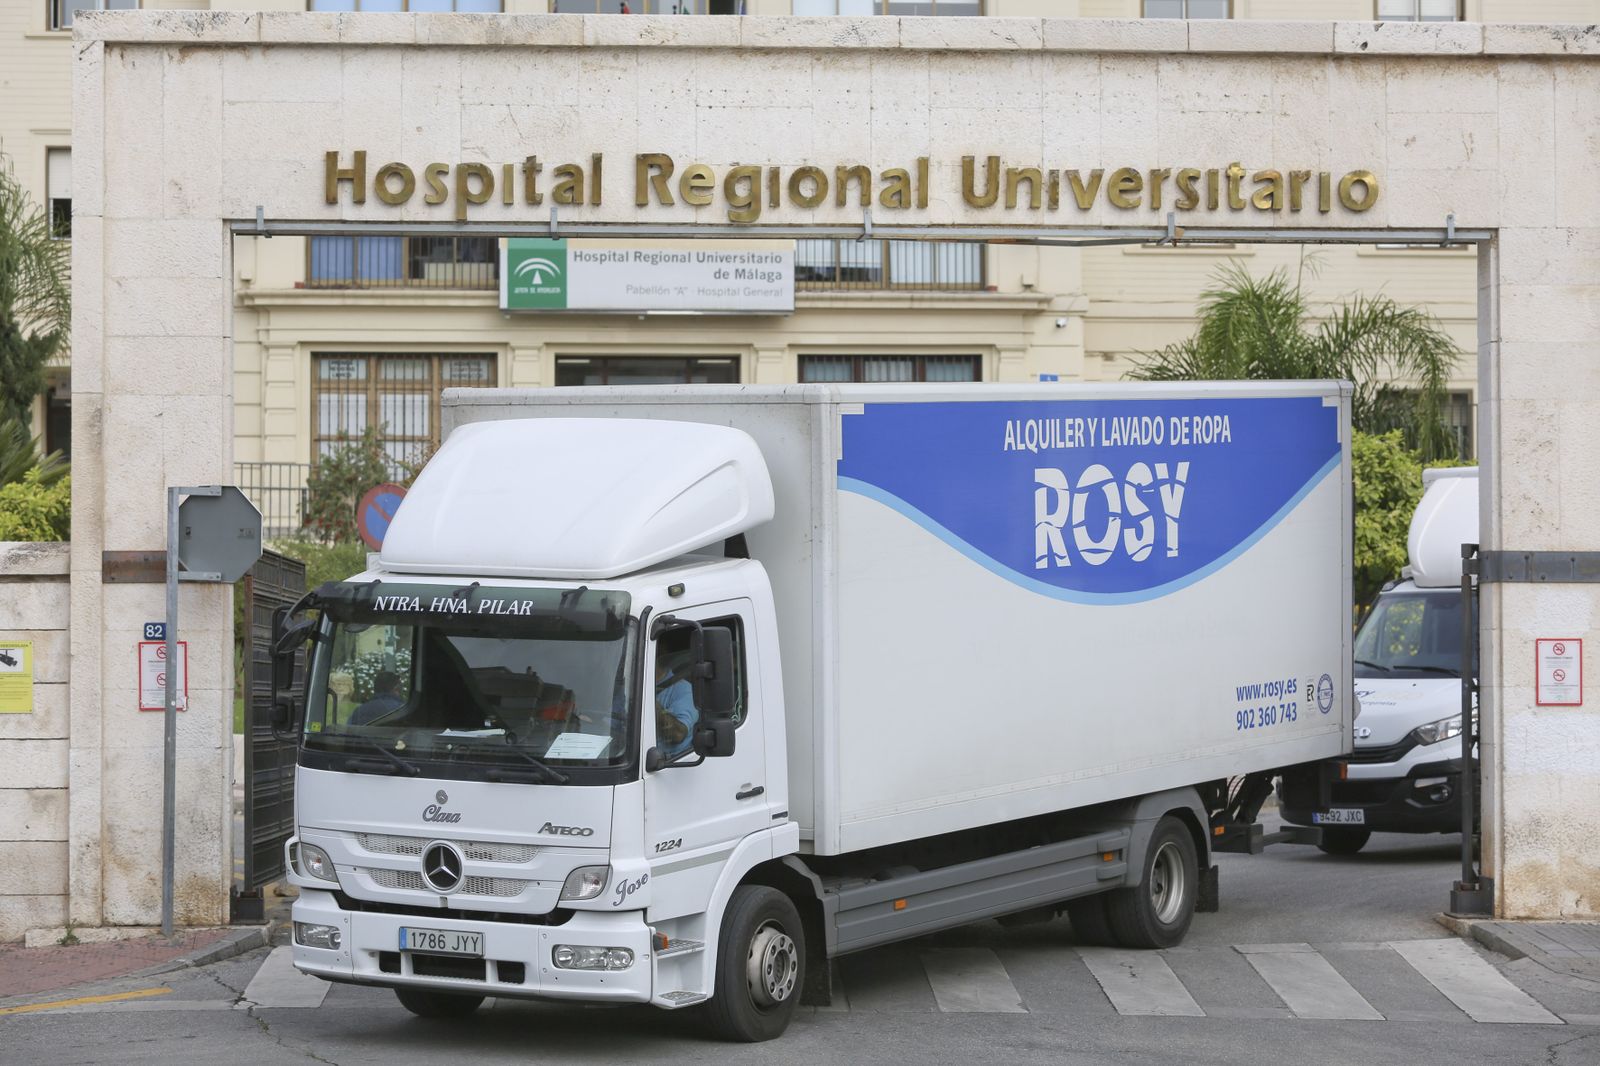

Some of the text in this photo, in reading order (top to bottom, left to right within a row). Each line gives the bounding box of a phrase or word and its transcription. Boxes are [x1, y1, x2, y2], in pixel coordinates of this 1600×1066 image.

[326, 150, 1378, 223] Hospital Regional Universitario
[574, 251, 782, 265] Hospital Regional Universitario
[713, 268, 782, 283] de Málaga
[626, 284, 670, 296] Pabellón
[697, 286, 740, 299] Hospital
[743, 287, 783, 297] General
[1004, 415, 1231, 453] ALQUILER Y LAVADO DE ROPA
[1035, 461, 1190, 569] ROSY
[373, 596, 533, 615] NTRA. HNA. PILAR
[146, 625, 163, 637] 82
[1236, 678, 1297, 701] www.rosy.es
[1236, 702, 1297, 731] 902 360 743
[422, 804, 461, 823] Clara
[1344, 810, 1363, 822] JXC
[655, 838, 682, 853] 1224
[613, 872, 649, 907] Jose
[411, 932, 479, 952] 1786 JYY
